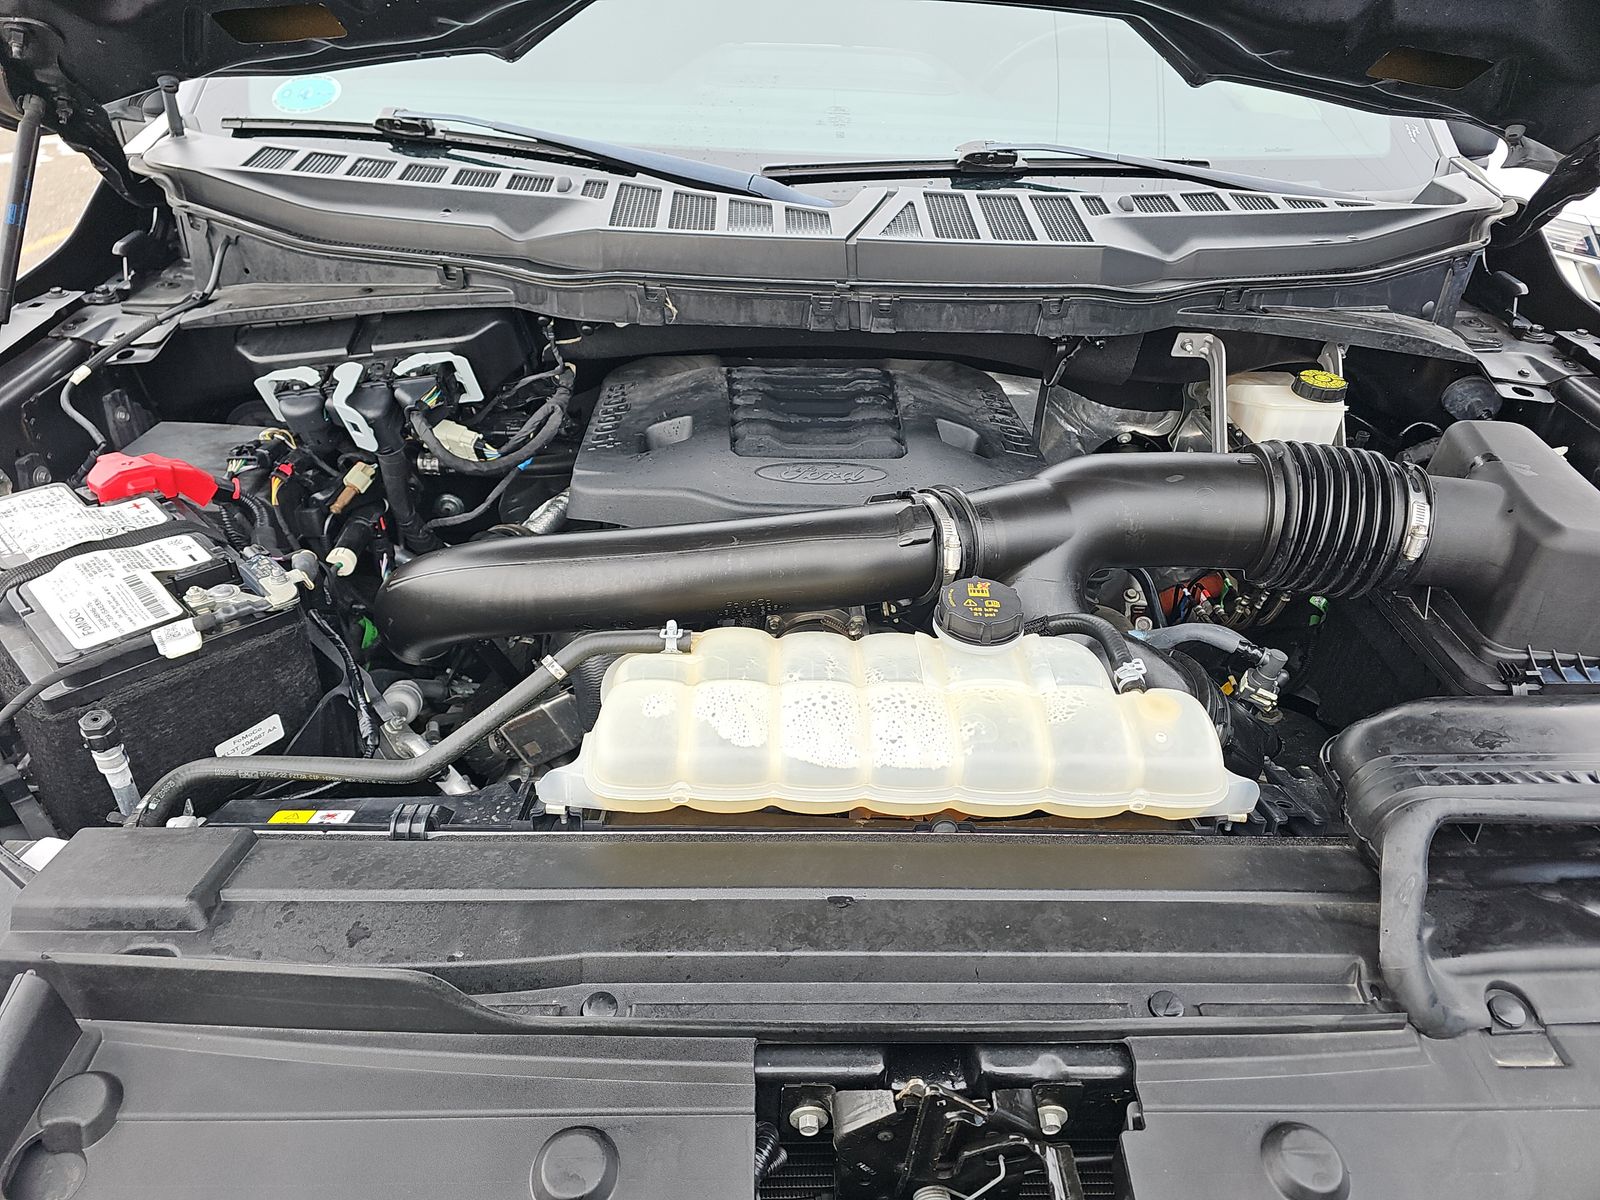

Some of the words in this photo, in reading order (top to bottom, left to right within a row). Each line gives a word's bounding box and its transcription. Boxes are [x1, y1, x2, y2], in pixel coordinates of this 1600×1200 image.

[780, 464, 866, 482] Ford
[69, 608, 95, 637] FoMoCo
[232, 727, 263, 746] FoMoCo
